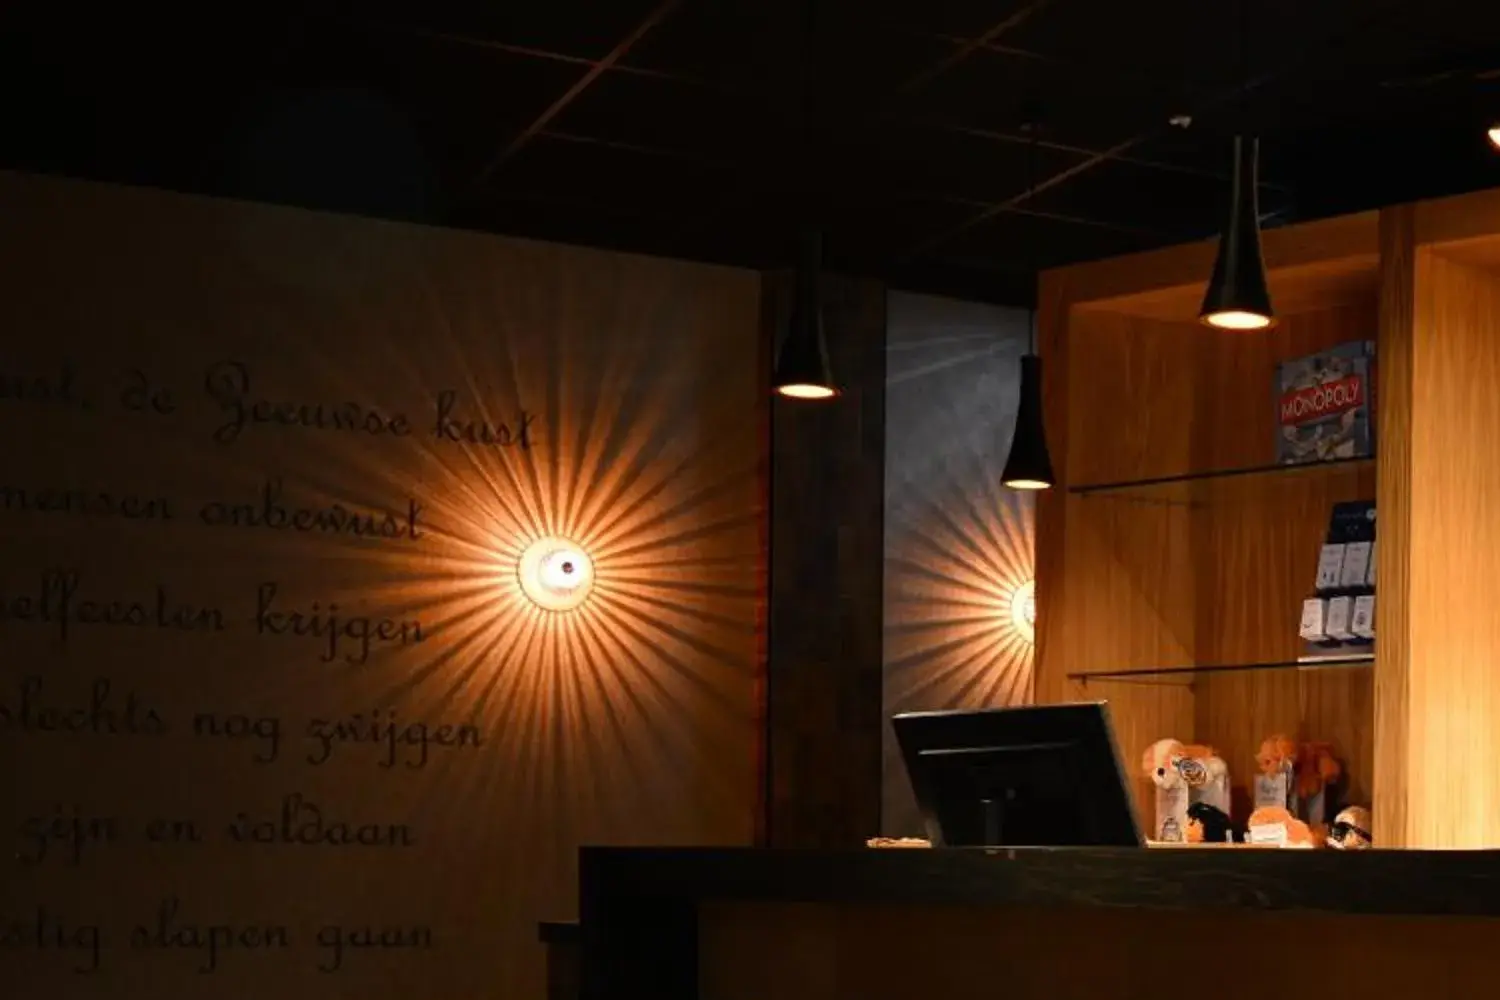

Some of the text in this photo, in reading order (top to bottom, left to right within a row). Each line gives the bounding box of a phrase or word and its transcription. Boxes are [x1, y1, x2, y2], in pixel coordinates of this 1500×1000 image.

[119, 367, 176, 415] de
[434, 390, 538, 451] kust
[1282, 383, 1360, 417] MONOPOLY
[198, 478, 424, 540] onbewust
[256, 582, 429, 663] krijgen
[193, 712, 282, 763] nog
[305, 705, 484, 768] zwijgen
[15, 793, 415, 867] zijn en voldaan
[129, 895, 290, 974] slapen
[316, 922, 433, 972] gaan
